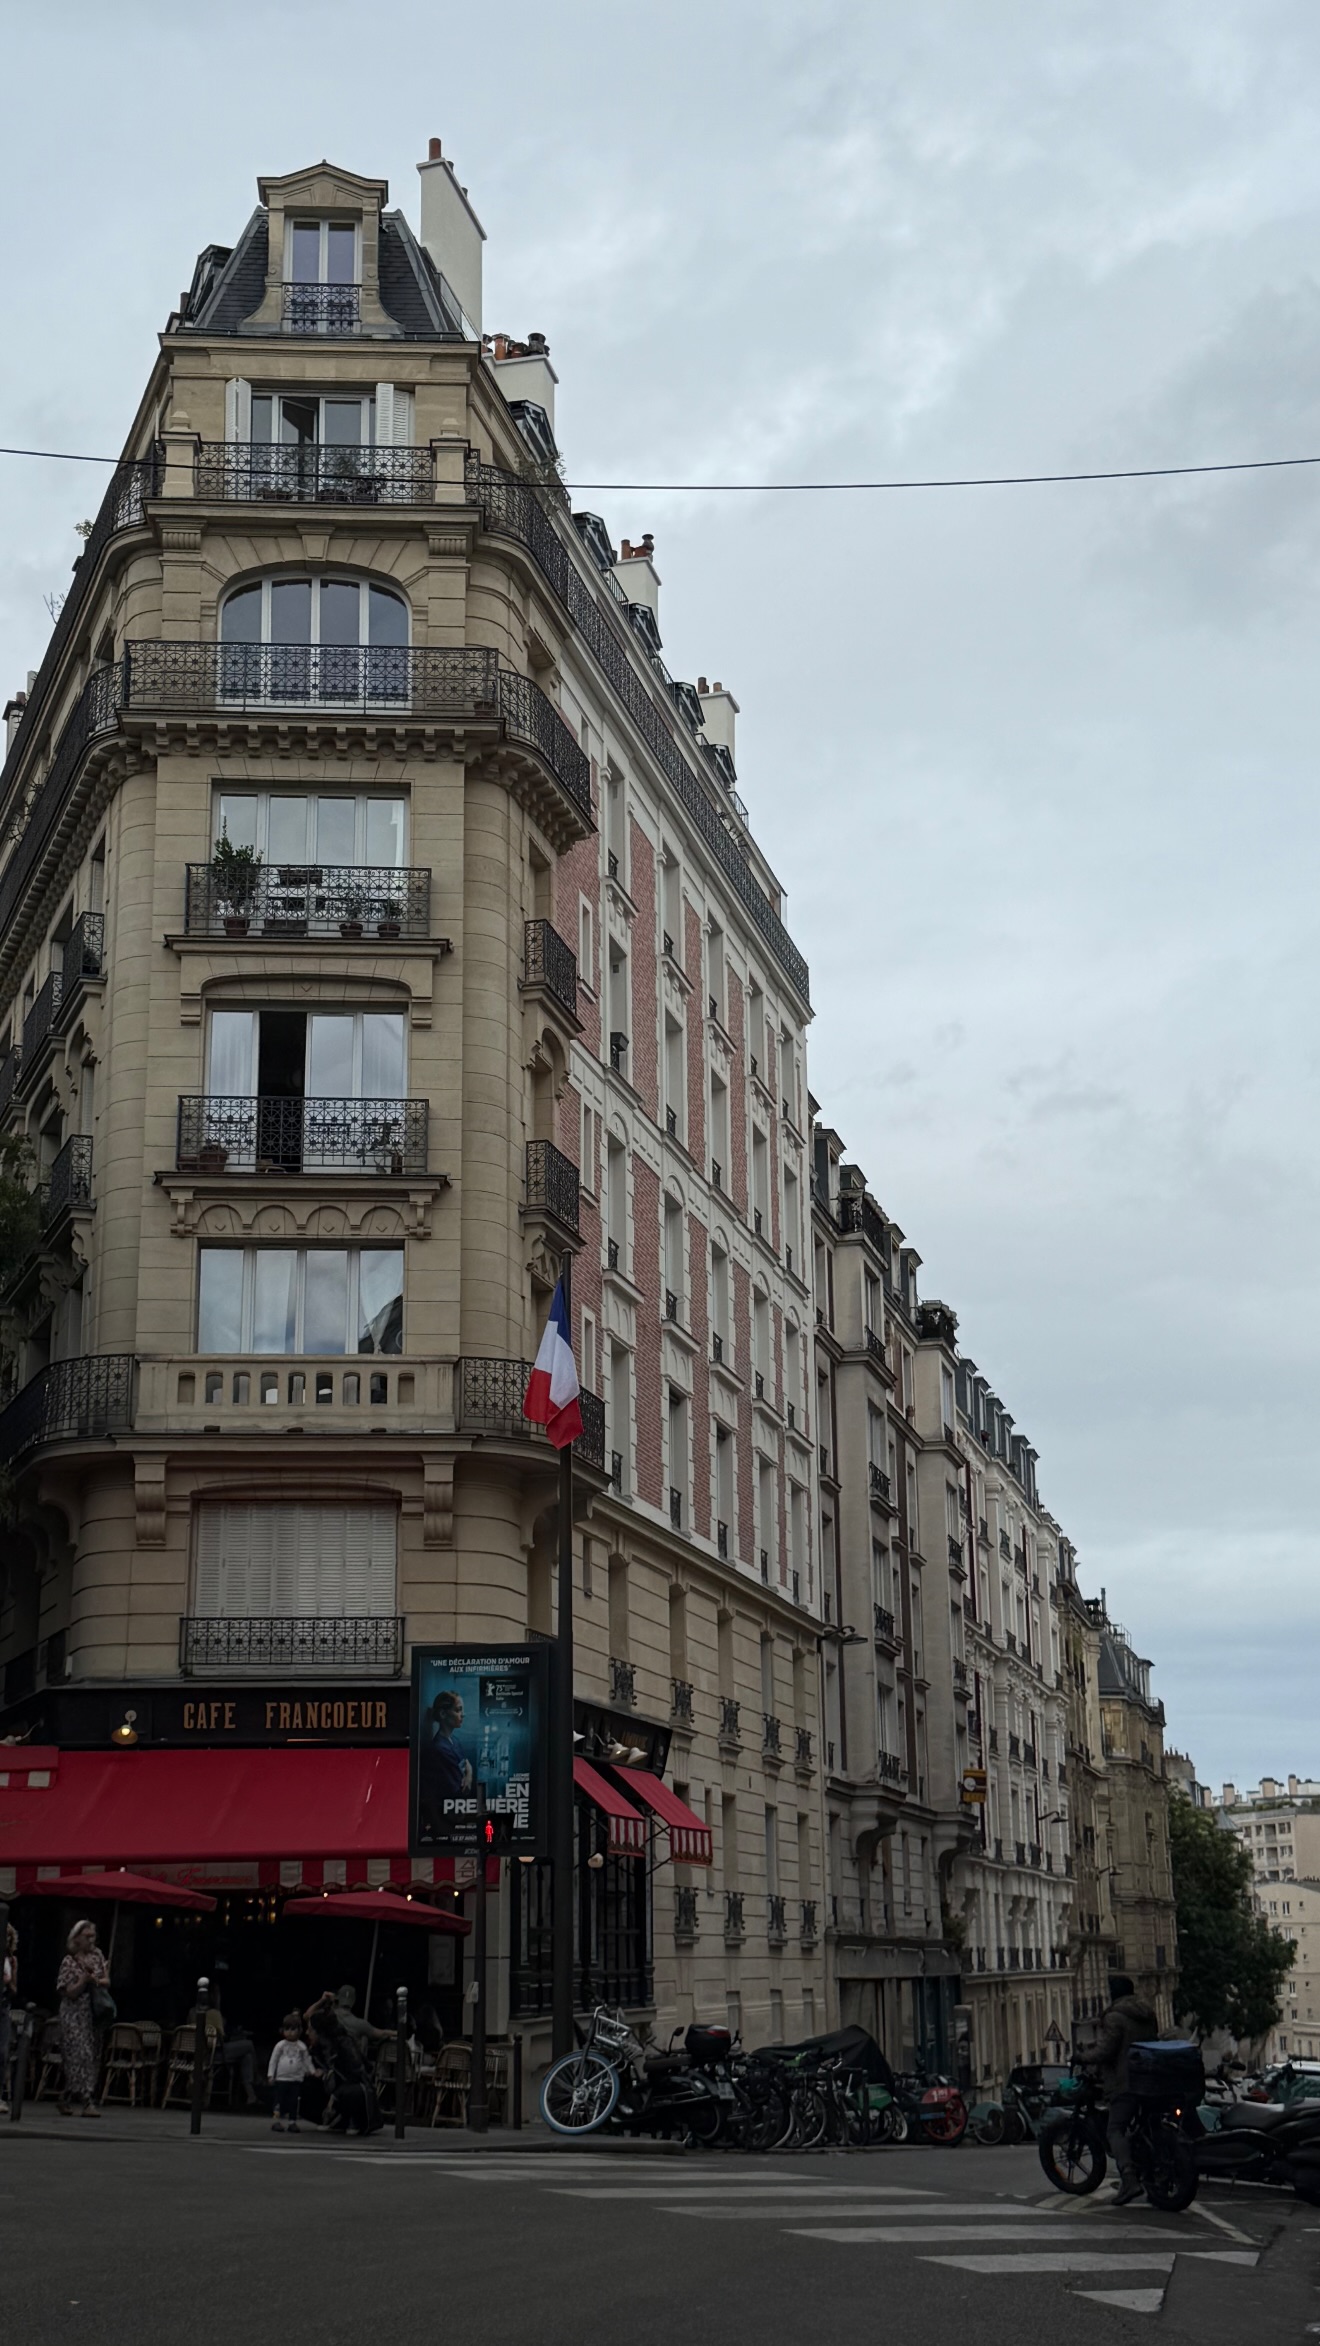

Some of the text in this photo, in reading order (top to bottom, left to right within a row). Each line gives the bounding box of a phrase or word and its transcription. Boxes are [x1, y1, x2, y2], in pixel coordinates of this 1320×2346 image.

[448, 1657, 497, 1666] DÉCLARATION
[498, 1656, 530, 1665] D'AMOUR
[449, 1665, 464, 1673] AUX
[183, 1701, 388, 1729] CAFE FRANCOEUR
[505, 1782, 530, 1798] EN
